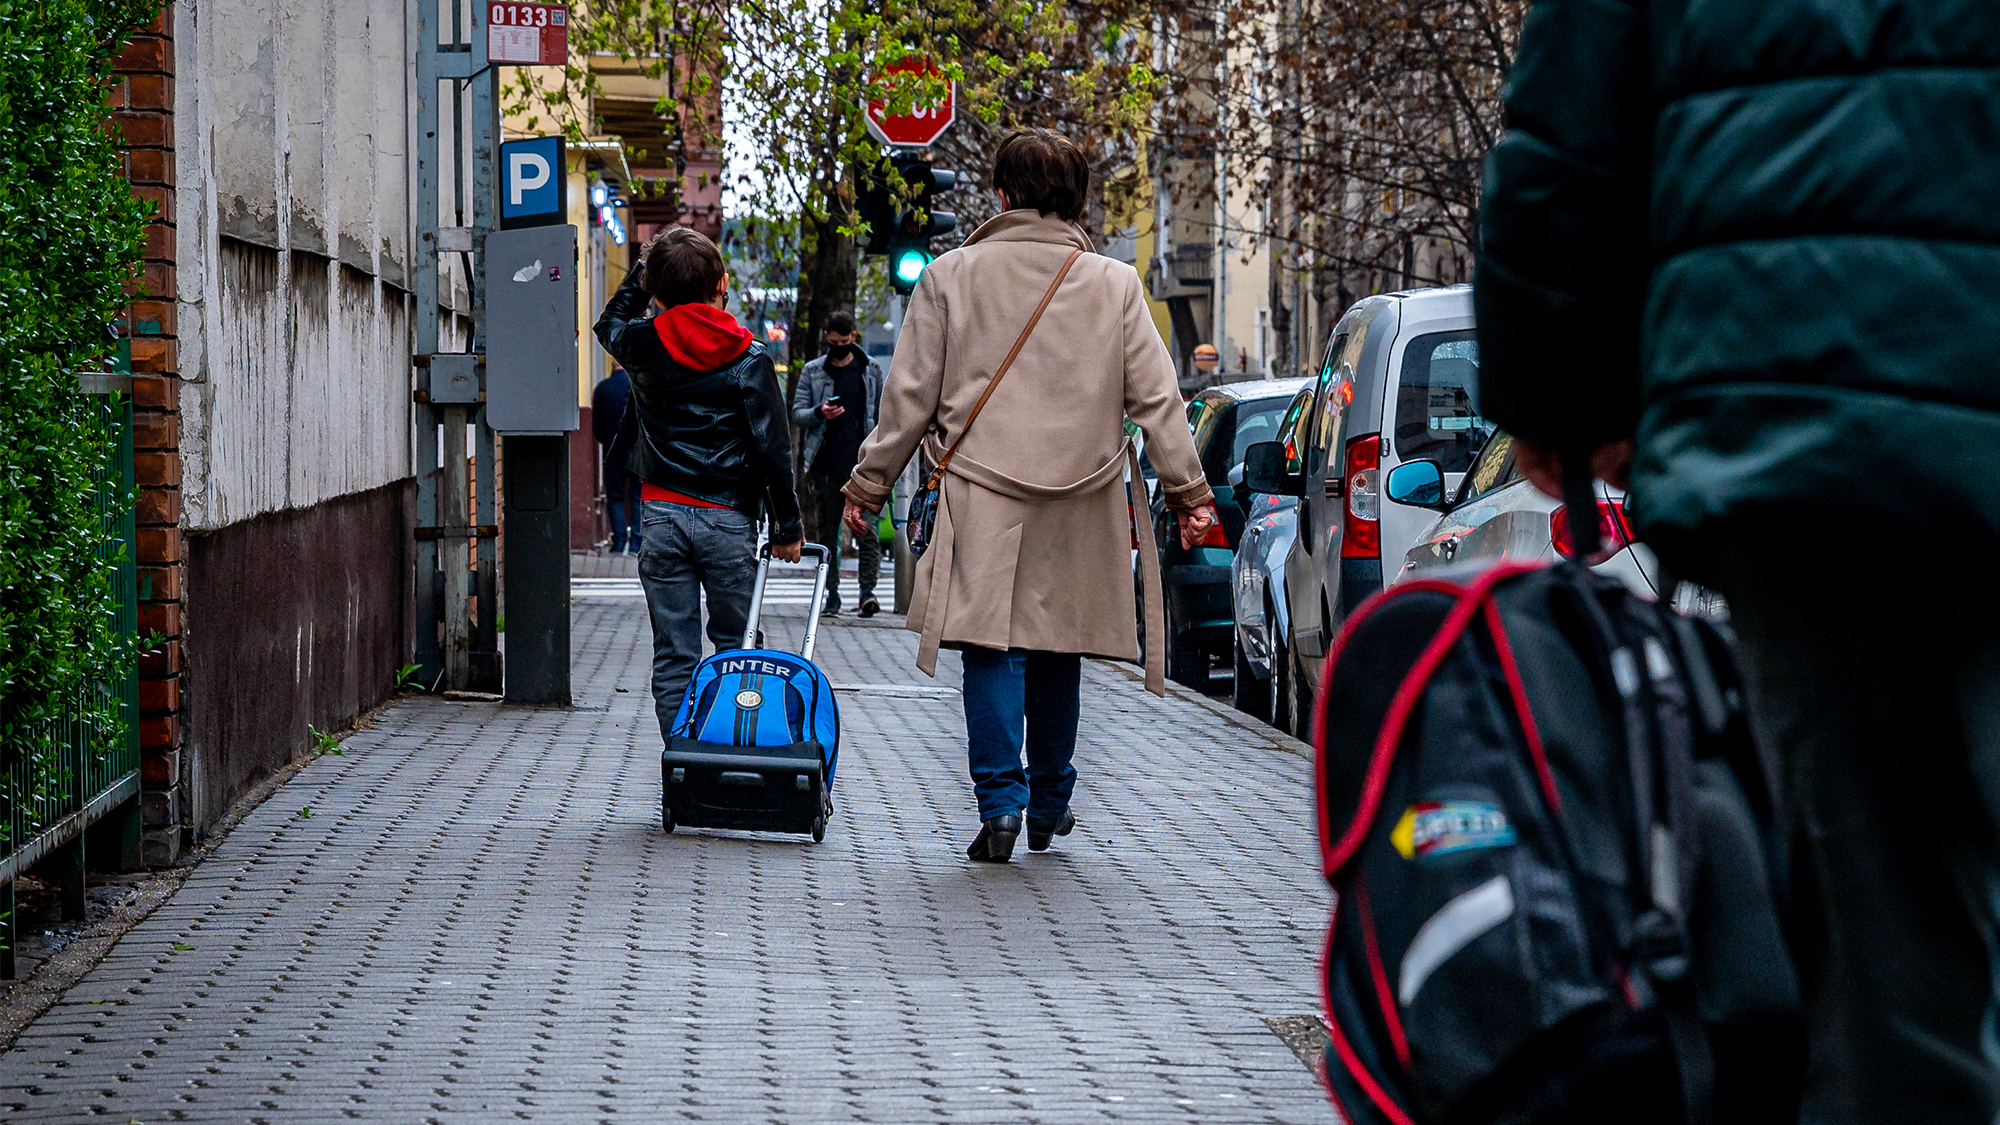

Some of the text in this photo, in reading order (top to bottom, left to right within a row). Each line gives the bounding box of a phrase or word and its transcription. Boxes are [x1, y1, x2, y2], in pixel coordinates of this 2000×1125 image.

[492, 5, 547, 27] 0133
[510, 153, 550, 205] P
[722, 660, 790, 676] INTER
